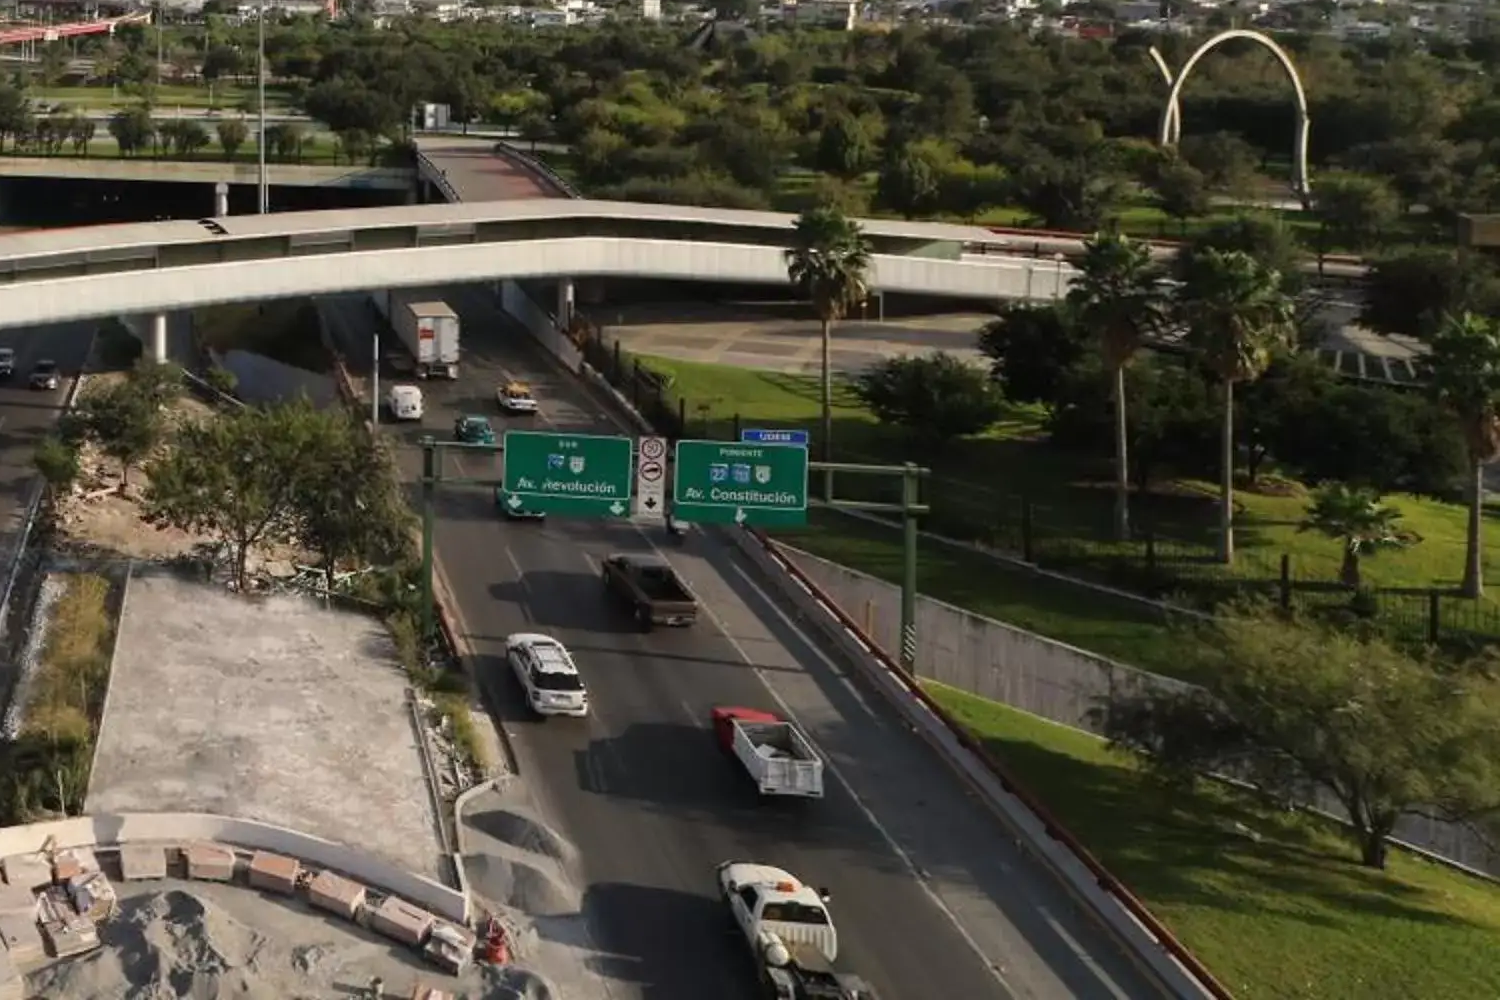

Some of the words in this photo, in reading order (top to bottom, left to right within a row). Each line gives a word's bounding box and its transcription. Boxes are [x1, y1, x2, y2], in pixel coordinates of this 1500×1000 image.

[517, 476, 537, 489] Av.
[685, 487, 705, 500] Av.
[710, 487, 796, 504] Constitución
